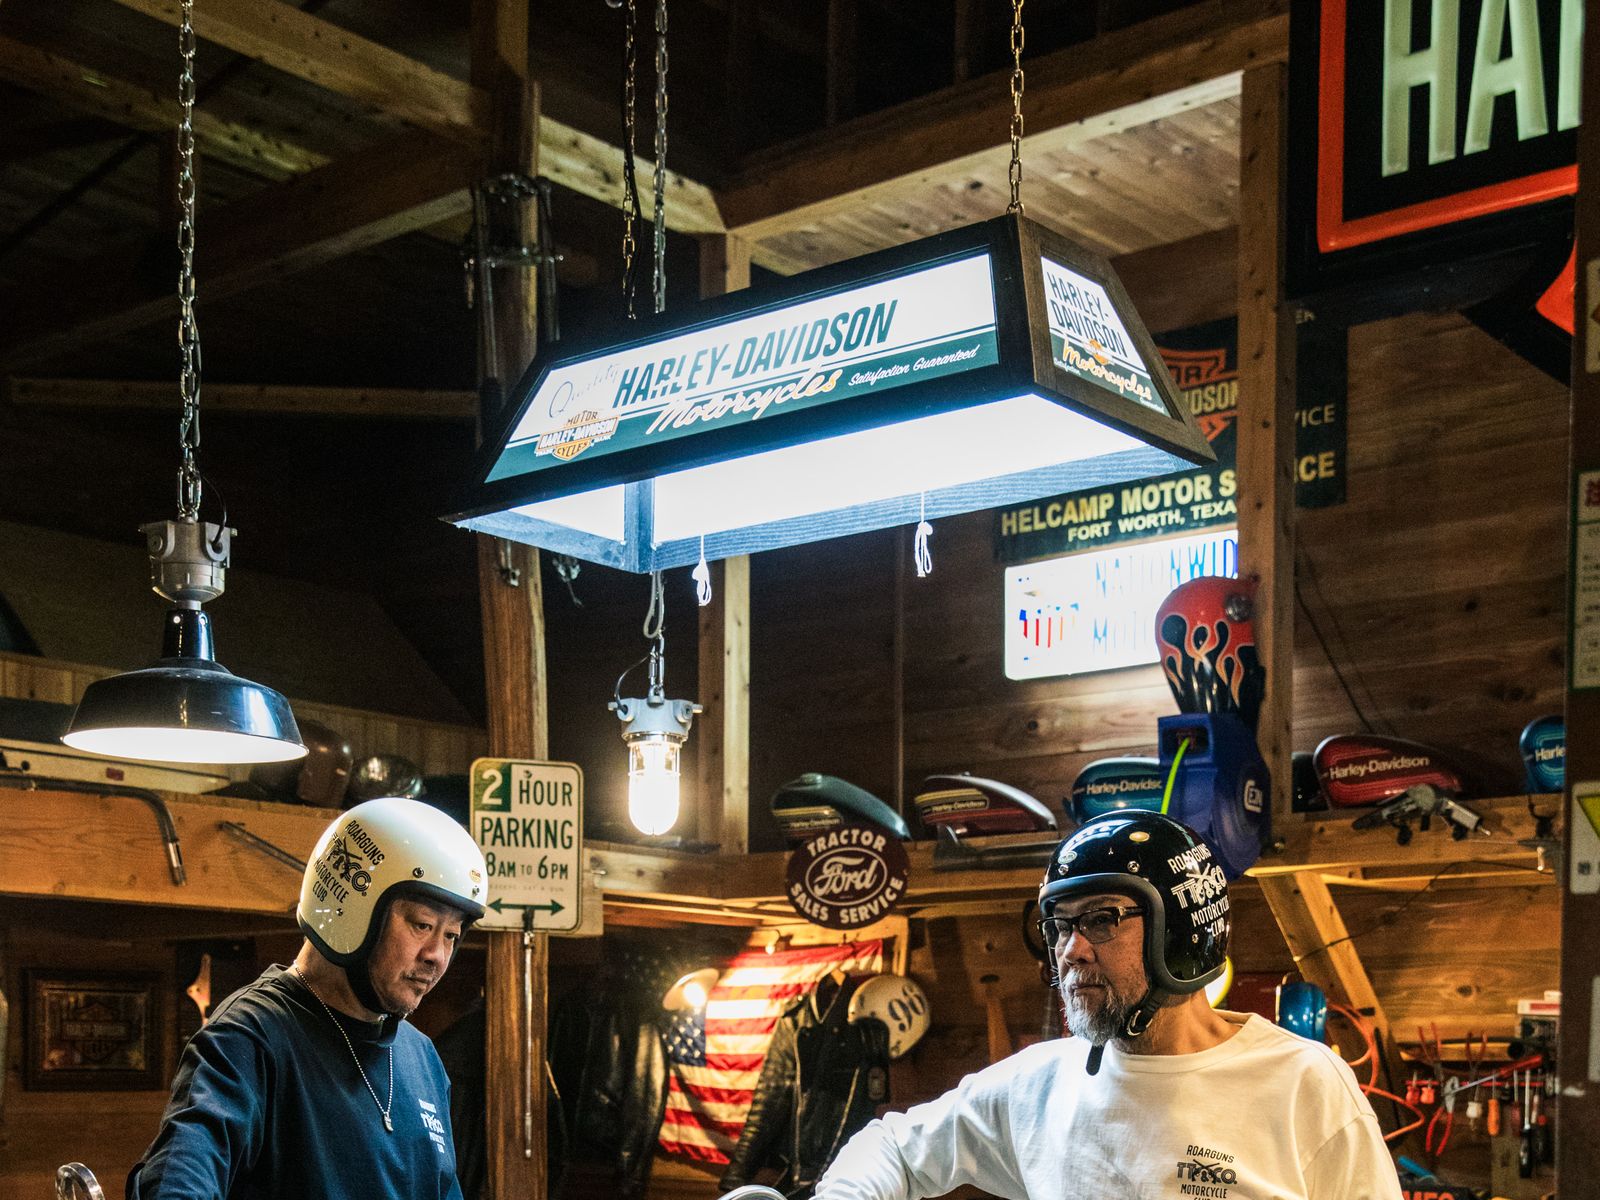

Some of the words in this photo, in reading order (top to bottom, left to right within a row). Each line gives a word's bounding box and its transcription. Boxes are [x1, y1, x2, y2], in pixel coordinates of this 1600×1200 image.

[1047, 271, 1108, 321] HARLEY-
[1050, 300, 1128, 358] DAVIDSON
[612, 300, 898, 409] HARLEY-DAVIDSON
[848, 363, 910, 386] Satisfaction
[913, 344, 981, 372] Guaranteed
[1062, 334, 1153, 401] Motorcycles
[645, 360, 843, 435] Motorcycles
[566, 410, 598, 425] MOTOR
[556, 441, 588, 457] CYCLES
[1001, 492, 1115, 537] HELCAMP
[1121, 474, 1212, 517] MOTOR
[1068, 520, 1112, 543] FORT
[1118, 508, 1185, 533] WORTH,
[481, 768, 503, 806] 2
[519, 779, 573, 807] HOUR
[1330, 756, 1430, 780] Harley-Davidson
[345, 819, 386, 866] ROARGUNS
[480, 816, 573, 850] PARKING
[806, 828, 887, 858] TRACTOR
[521, 864, 532, 876] TO
[813, 857, 880, 898] Ford
[1167, 843, 1212, 875] ROARGUNS
[312, 880, 328, 903] CLUB
[314, 858, 350, 904] MOTORCYCLE
[790, 882, 829, 922] SALES
[839, 876, 904, 925] SERVICE
[1186, 1144, 1235, 1164] ROARGUNS
[1180, 1183, 1228, 1199] MOTORCYCLE
